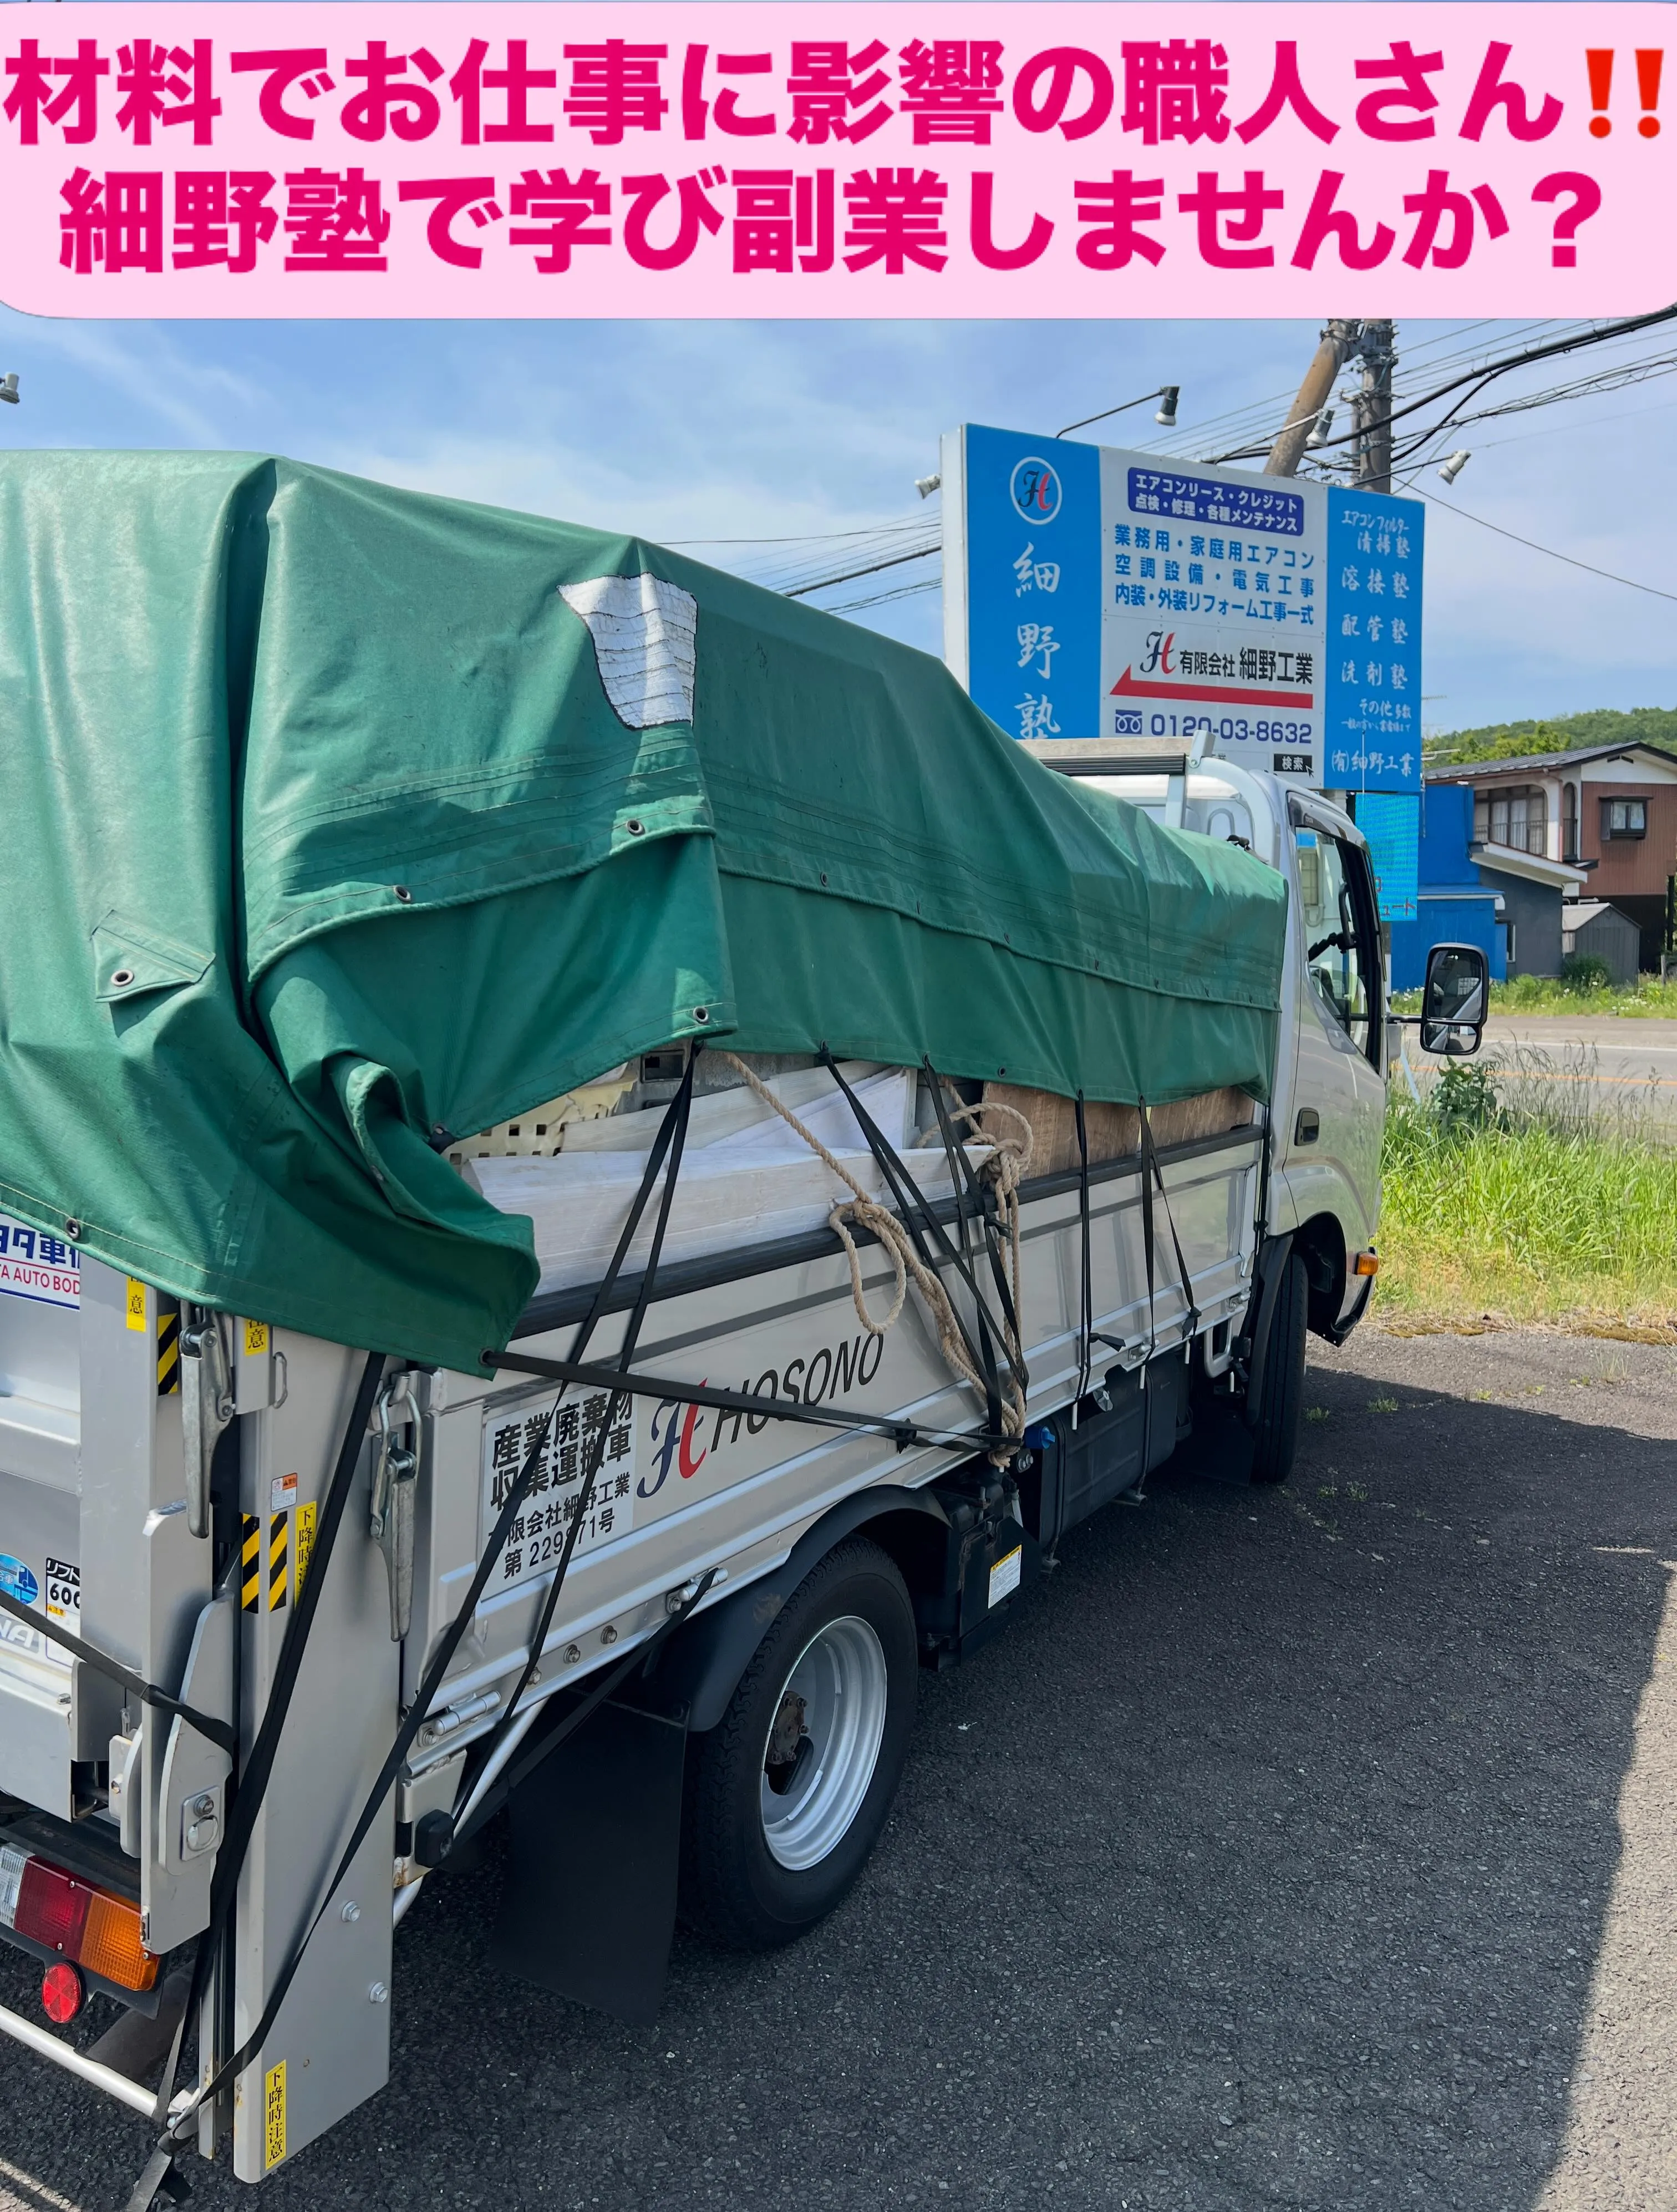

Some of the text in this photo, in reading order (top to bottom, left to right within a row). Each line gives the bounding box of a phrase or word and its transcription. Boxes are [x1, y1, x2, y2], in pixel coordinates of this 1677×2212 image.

[1135, 493, 1298, 532] 点検・修理・各種メンテナンス
[1136, 474, 1297, 514] エアコンリース・クレジット
[1115, 523, 1314, 570] 業務用・家庭用エアコン
[1115, 552, 1314, 598] 空調設備・電気工事
[1341, 565, 1410, 599] 溶接塾
[1115, 582, 1314, 626] 内装・外装リフォーム工事一式
[1013, 541, 1061, 740] 細野塾
[1341, 613, 1409, 645] 配管塾
[1151, 713, 1312, 744] 0120-03-8632
[1281, 755, 1303, 772] 検索
[13, 1267, 50, 1288] AUTO
[710, 1332, 884, 1453] HOSONO
[489, 1472, 631, 1548] 限会社細野工業
[504, 1507, 615, 1580] 第22971号
[268, 2066, 283, 2162] 下降時注意
